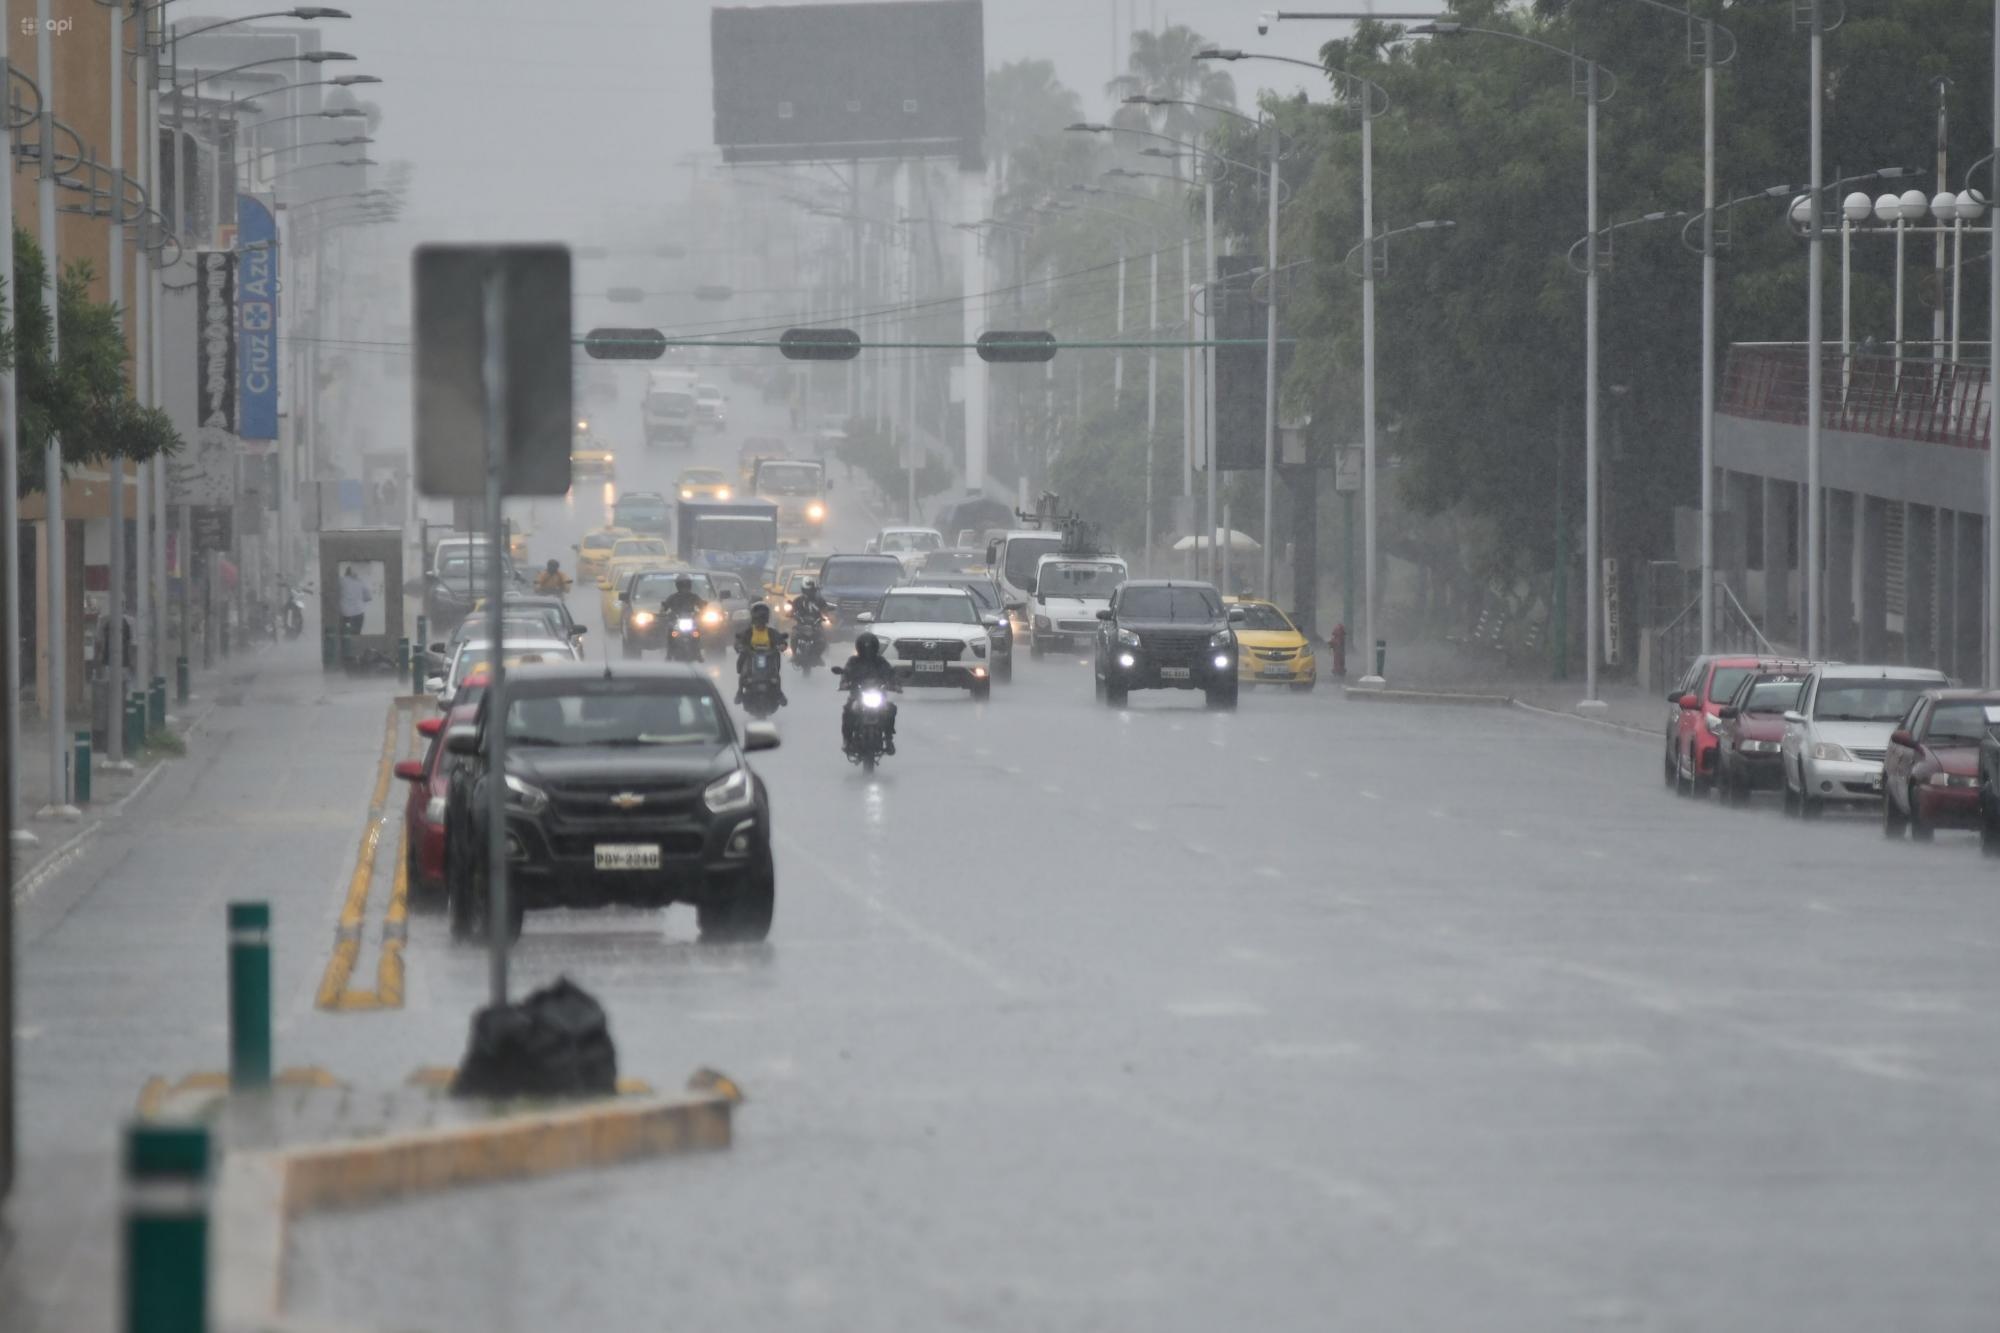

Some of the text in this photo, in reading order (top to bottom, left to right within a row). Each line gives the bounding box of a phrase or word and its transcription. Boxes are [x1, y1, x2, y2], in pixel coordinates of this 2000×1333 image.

[245, 240, 270, 393] Cruz Azul
[1607, 559, 1617, 663] IMPRENTA
